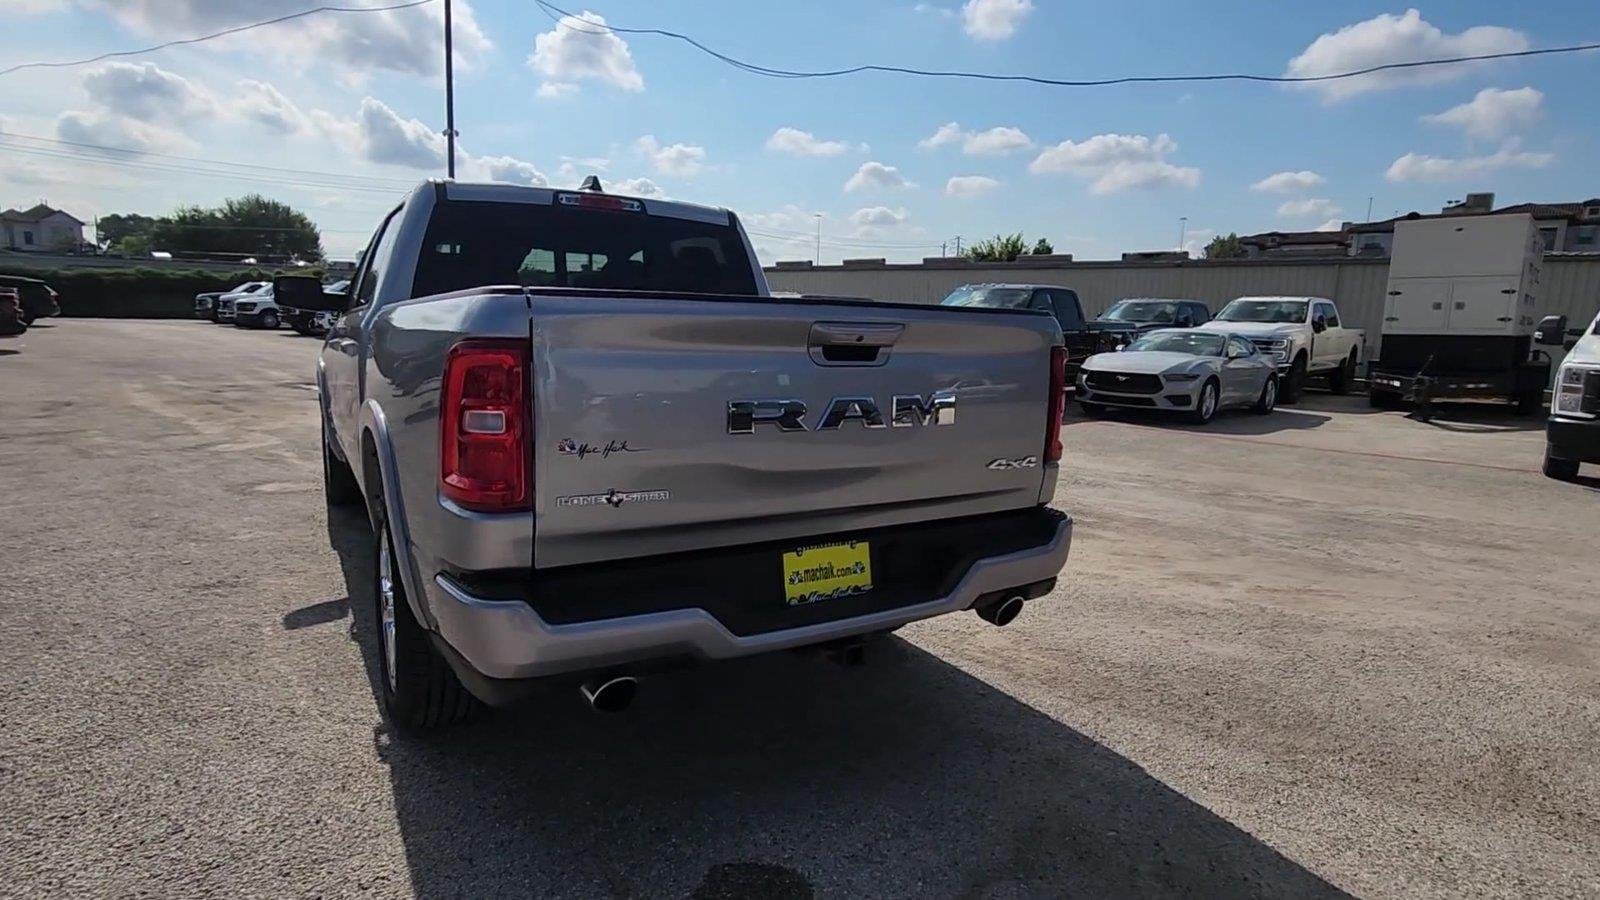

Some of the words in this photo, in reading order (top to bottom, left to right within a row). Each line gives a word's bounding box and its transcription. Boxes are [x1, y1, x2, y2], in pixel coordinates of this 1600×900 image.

[727, 393, 956, 435] RAM
[577, 443, 600, 460] Mac
[602, 440, 632, 459] Haik
[986, 455, 1037, 470] 4x4
[556, 494, 608, 507] LONE
[803, 561, 852, 583] machaik.com
